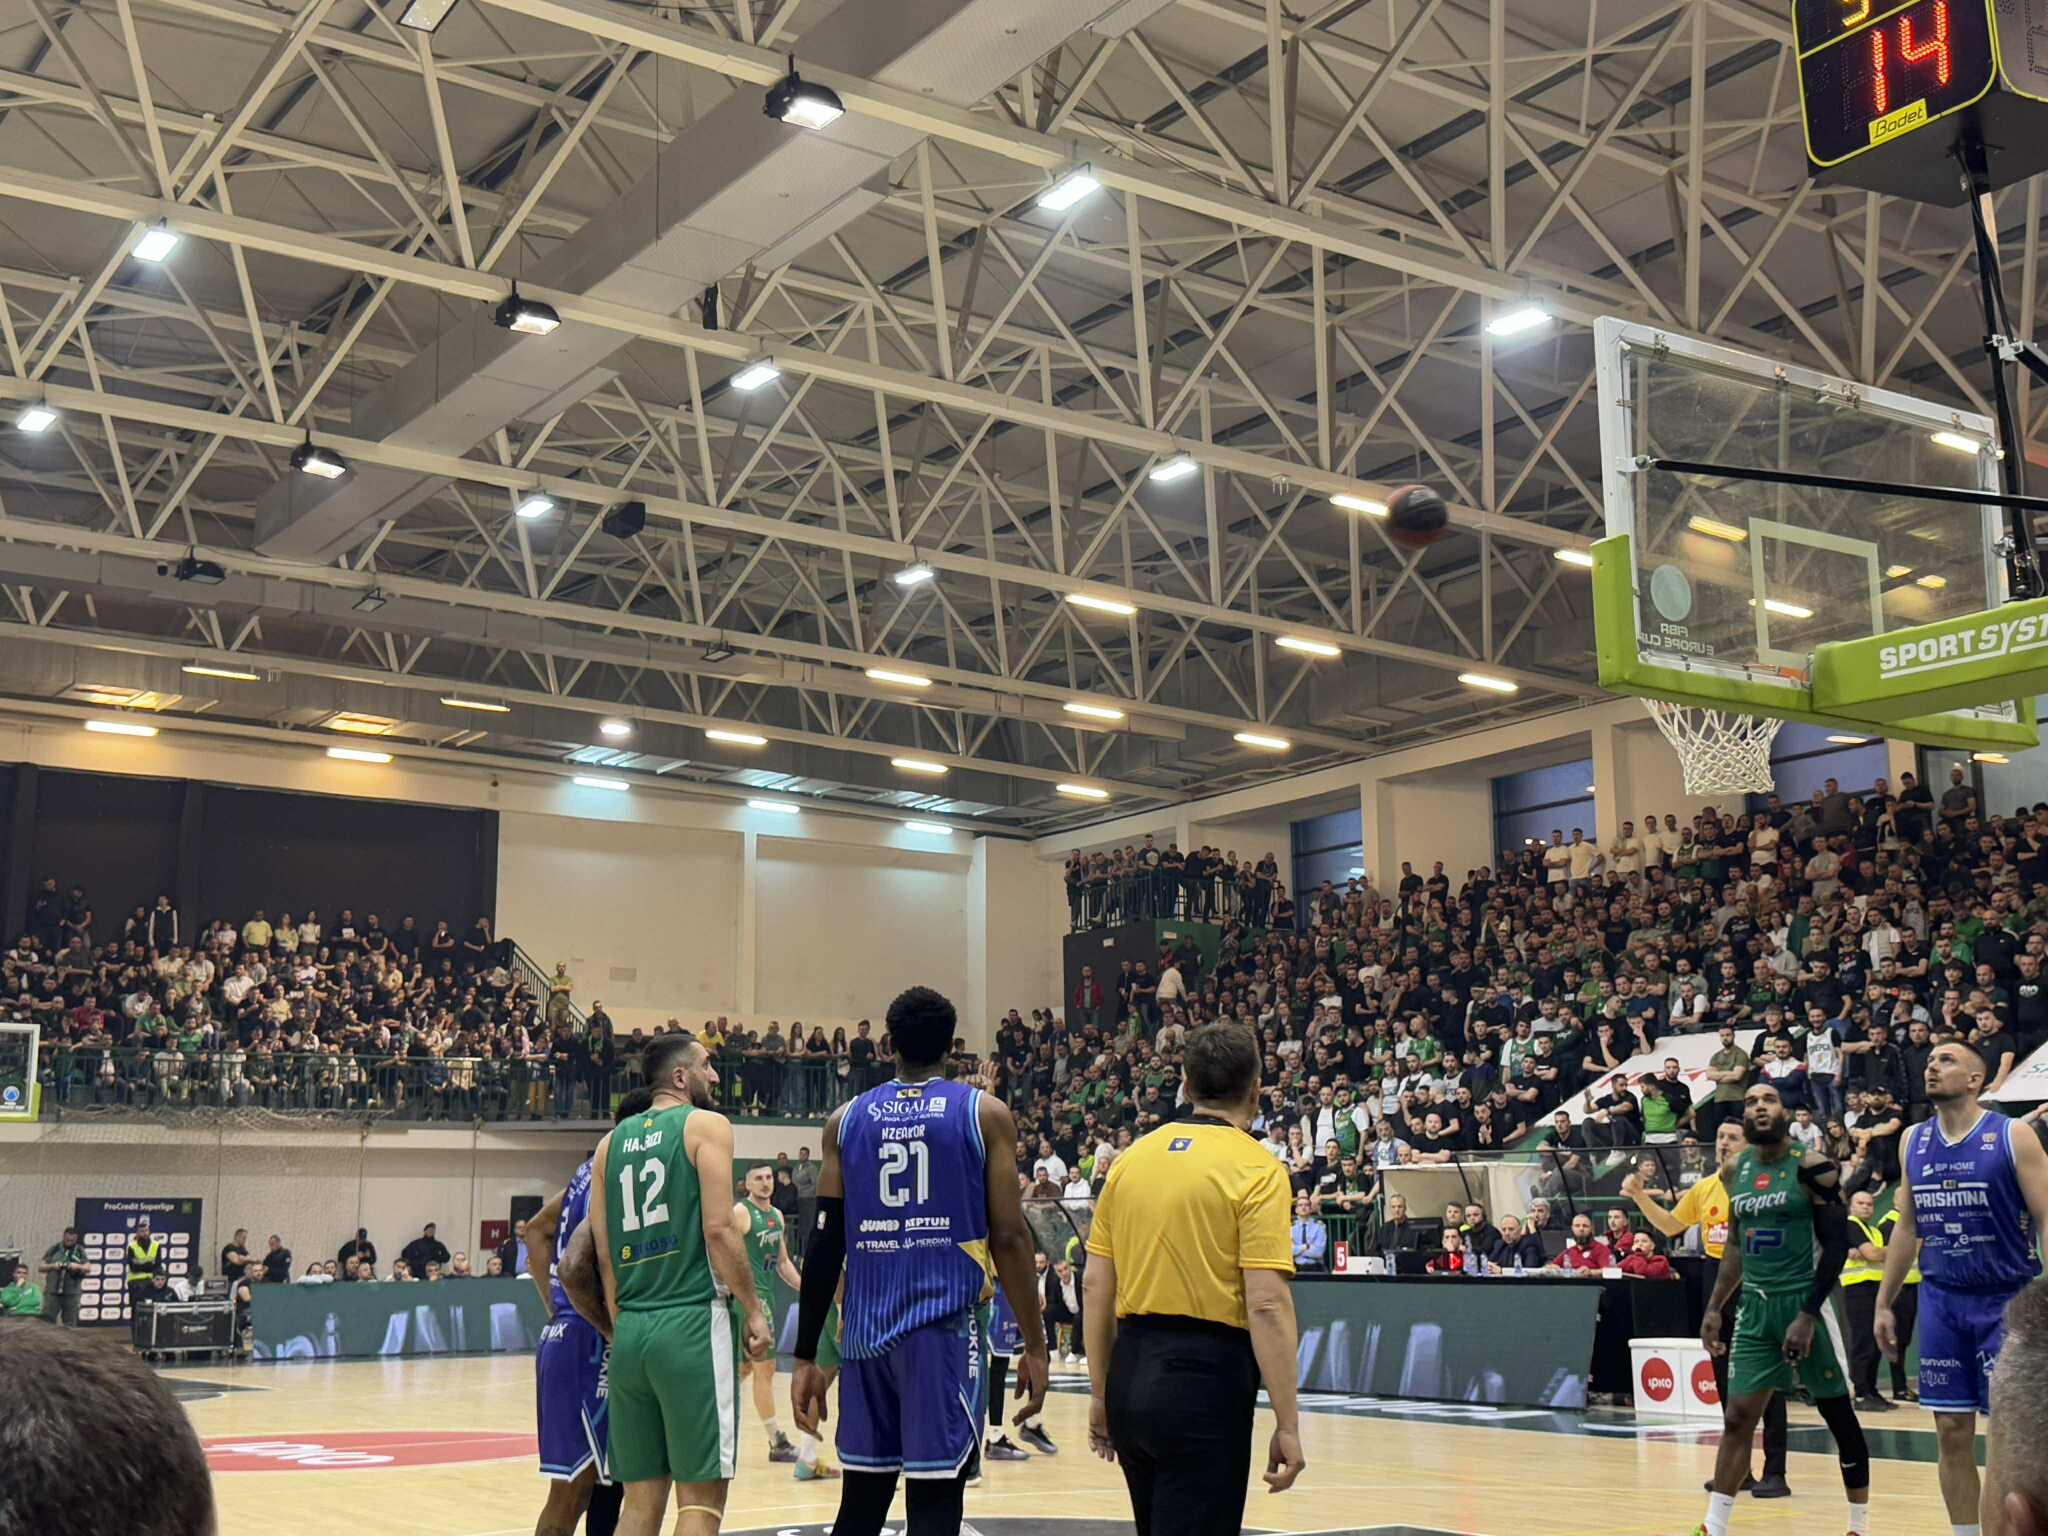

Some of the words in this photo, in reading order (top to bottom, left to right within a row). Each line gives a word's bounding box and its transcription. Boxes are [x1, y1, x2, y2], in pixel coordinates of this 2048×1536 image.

[1871, 0, 1950, 113] 14
[1874, 106, 1923, 139] Bodet
[1880, 629, 1975, 671] SPORT
[882, 1099, 928, 1114] SIGAL
[881, 1124, 926, 1141] NZEAKOR
[879, 1141, 929, 1207] 21
[619, 1157, 670, 1233] 12
[1914, 1190, 1989, 1208] PRISHTINA
[866, 1240, 900, 1249] TRAVEL
[1336, 1246, 1345, 1267] 5
